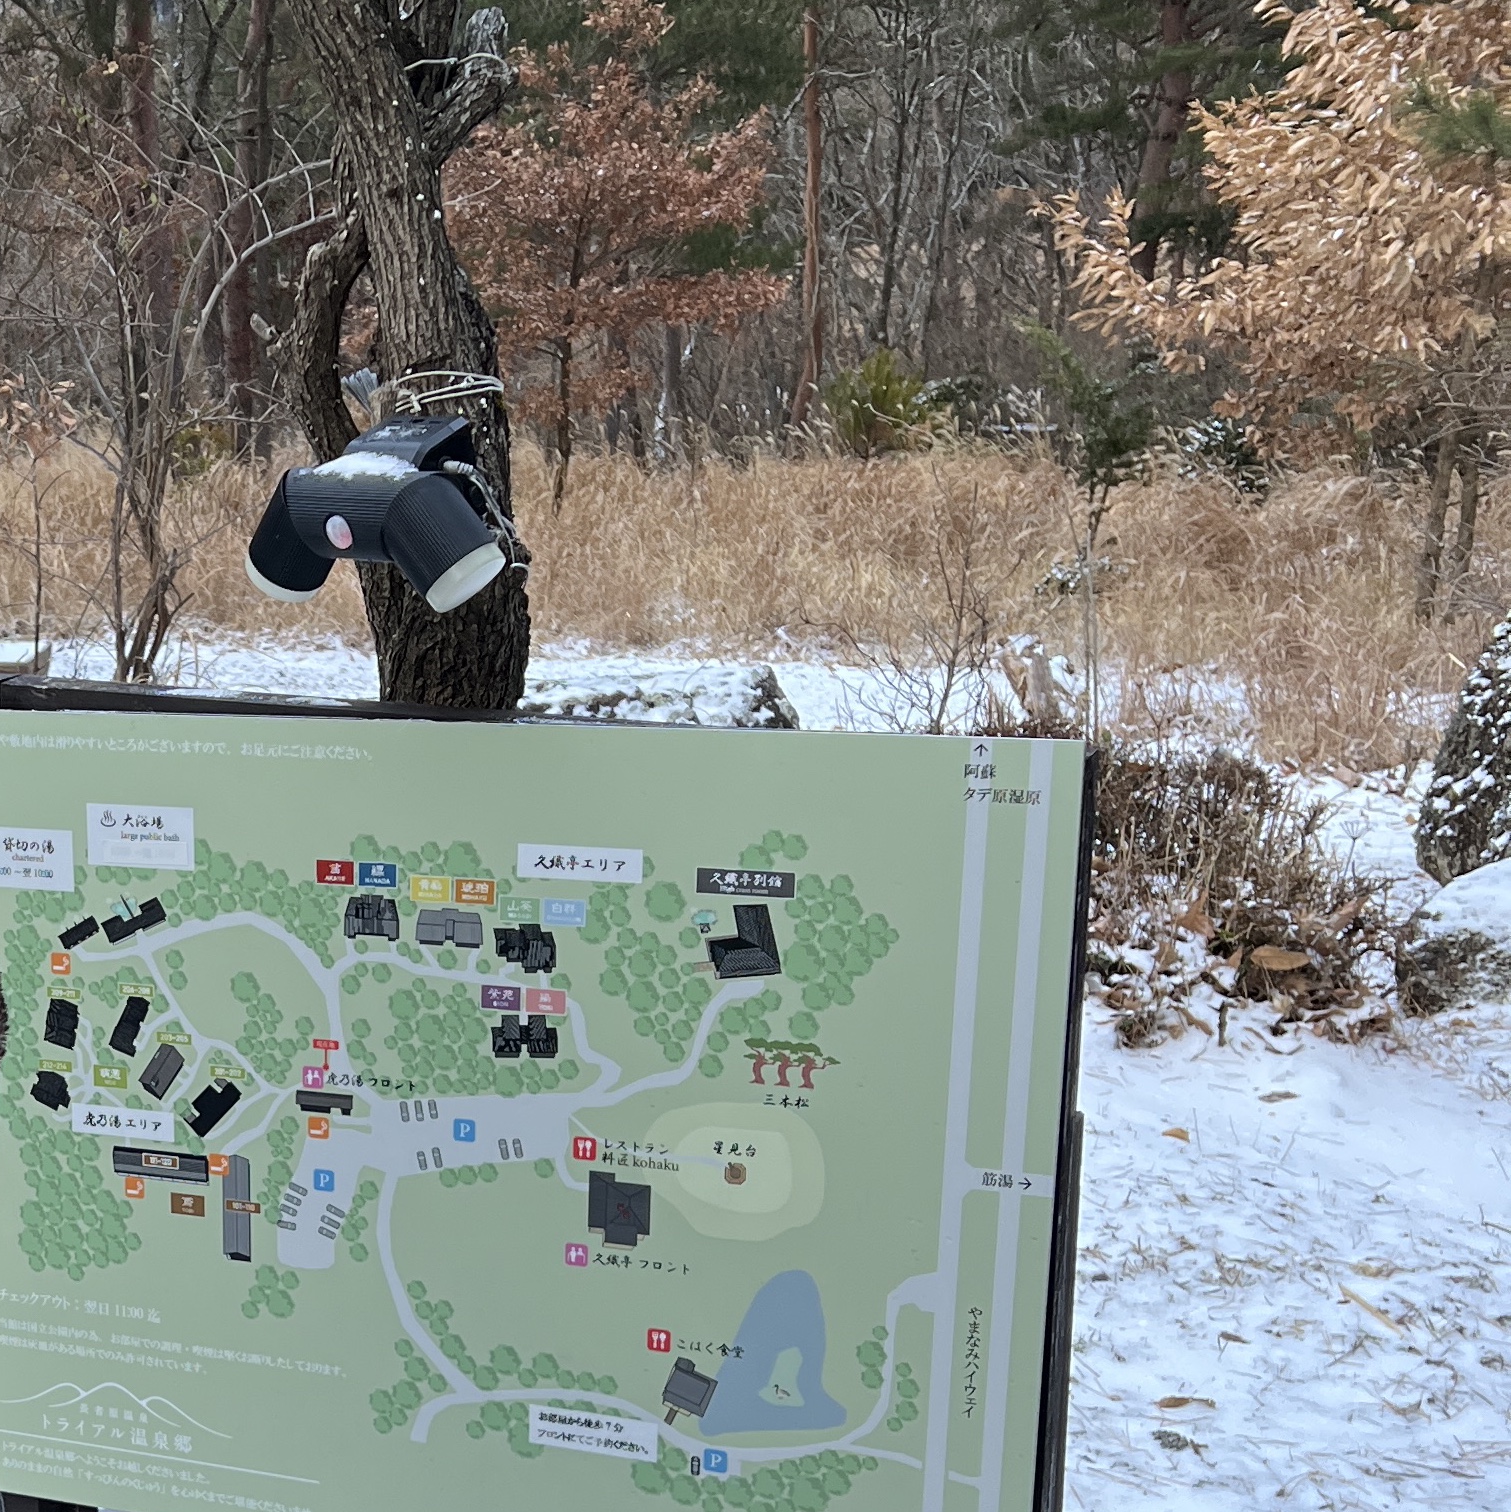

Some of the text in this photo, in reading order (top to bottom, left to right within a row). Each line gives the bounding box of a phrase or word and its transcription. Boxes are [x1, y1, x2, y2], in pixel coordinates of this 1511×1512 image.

[963, 763, 997, 780] 阿蘇
[963, 786, 1042, 806] タデ原湿原
[122, 814, 164, 830] 大浴場
[121, 830, 180, 842] large public bath
[3, 837, 54, 854] 貸切の湯
[12, 853, 44, 863] chartered
[534, 854, 626, 872] 久織亭エリア
[710, 871, 782, 888] 久織亭別館
[763, 1094, 810, 1109] 三本松
[83, 1112, 162, 1132] 虎乃湯エリア
[460, 1123, 470, 1138] P
[604, 1138, 669, 1156] レストラン
[713, 1141, 757, 1158] 星見台
[602, 1152, 680, 1172] 料匠 kohaku
[320, 1173, 330, 1187] P
[982, 1172, 1014, 1189] 筋湯
[114, 1304, 144, 1319] 11:00
[677, 1339, 745, 1359] こはく食堂
[962, 1306, 983, 1419] やまなみハイウェイ
[43, 1413, 193, 1454] トライアル温泉郷
[710, 1453, 722, 1468] P
